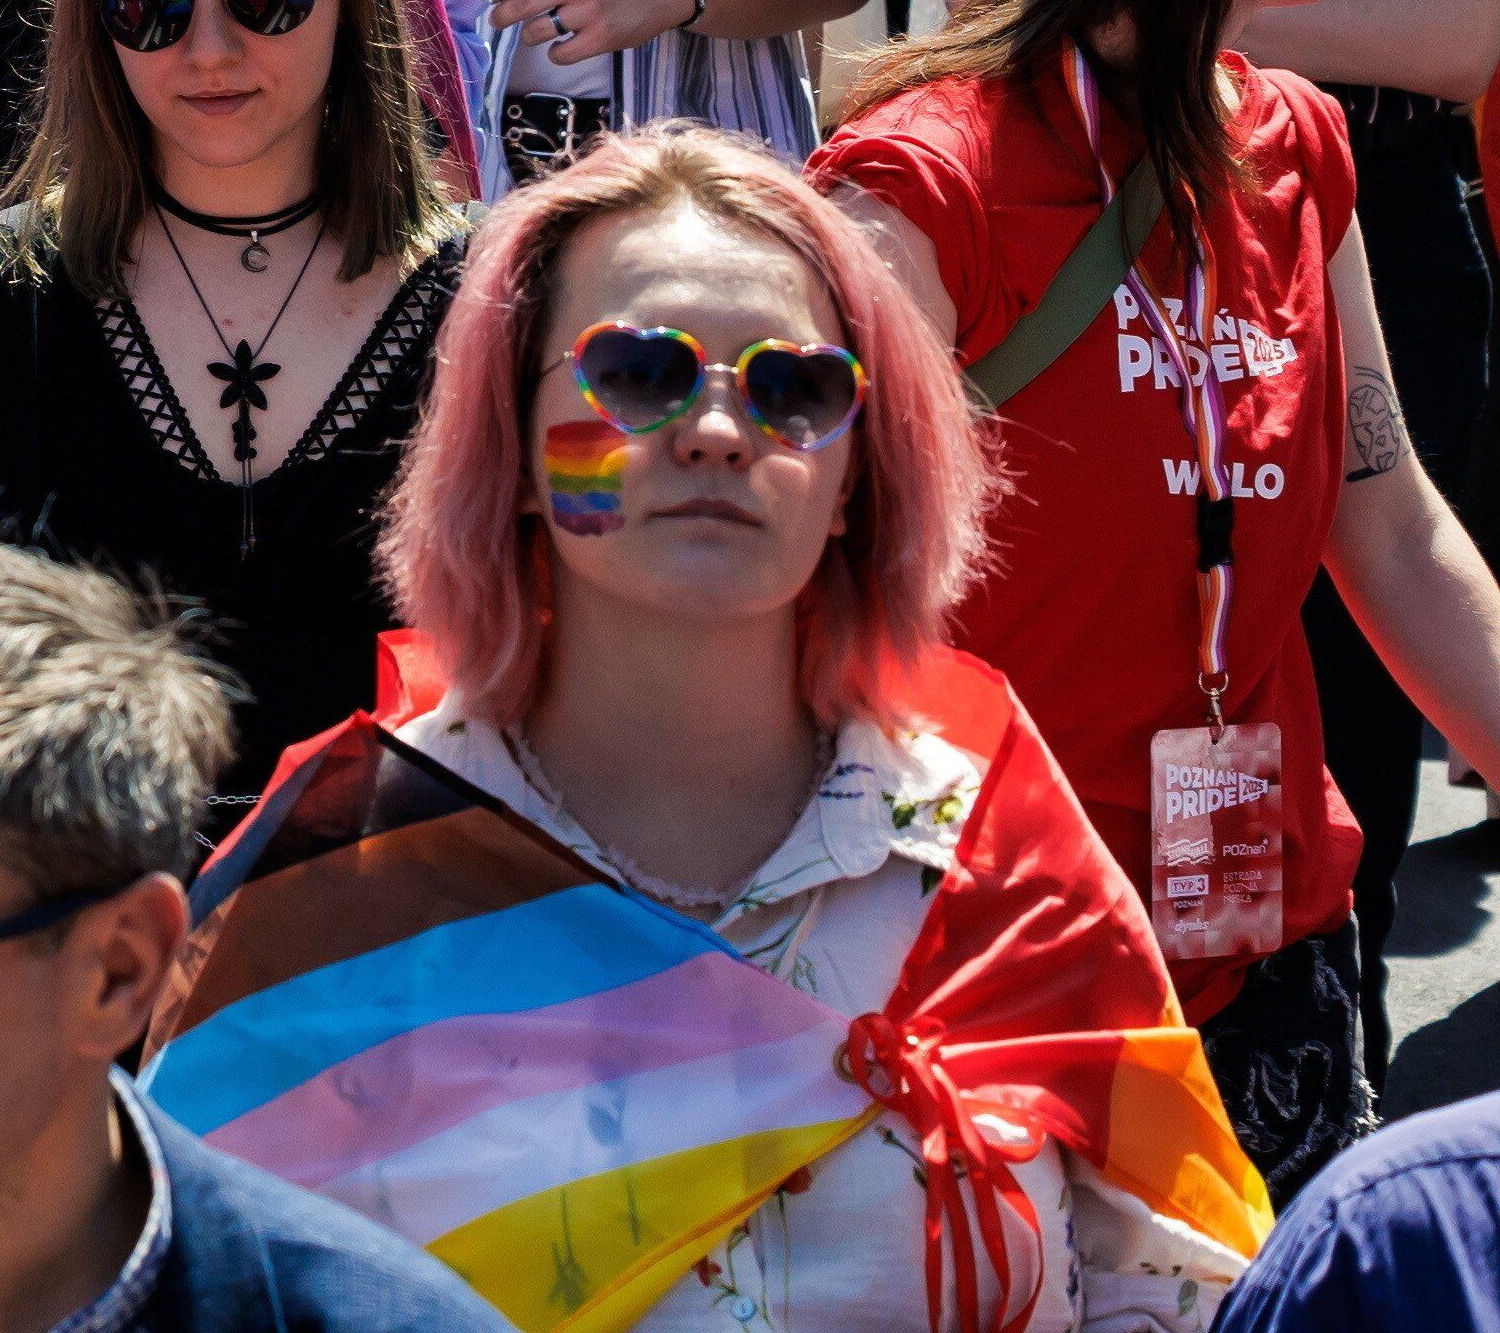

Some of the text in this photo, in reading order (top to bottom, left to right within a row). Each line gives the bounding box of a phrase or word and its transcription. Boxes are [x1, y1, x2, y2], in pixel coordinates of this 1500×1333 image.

[1114, 283, 1236, 341] PZŃ
[1118, 334, 1244, 393] PRDE
[1252, 334, 1286, 364] 2025
[1162, 459, 1286, 500] WLO
[1166, 787, 1238, 824] PRIDE
[1173, 877, 1206, 893] TVP 3
